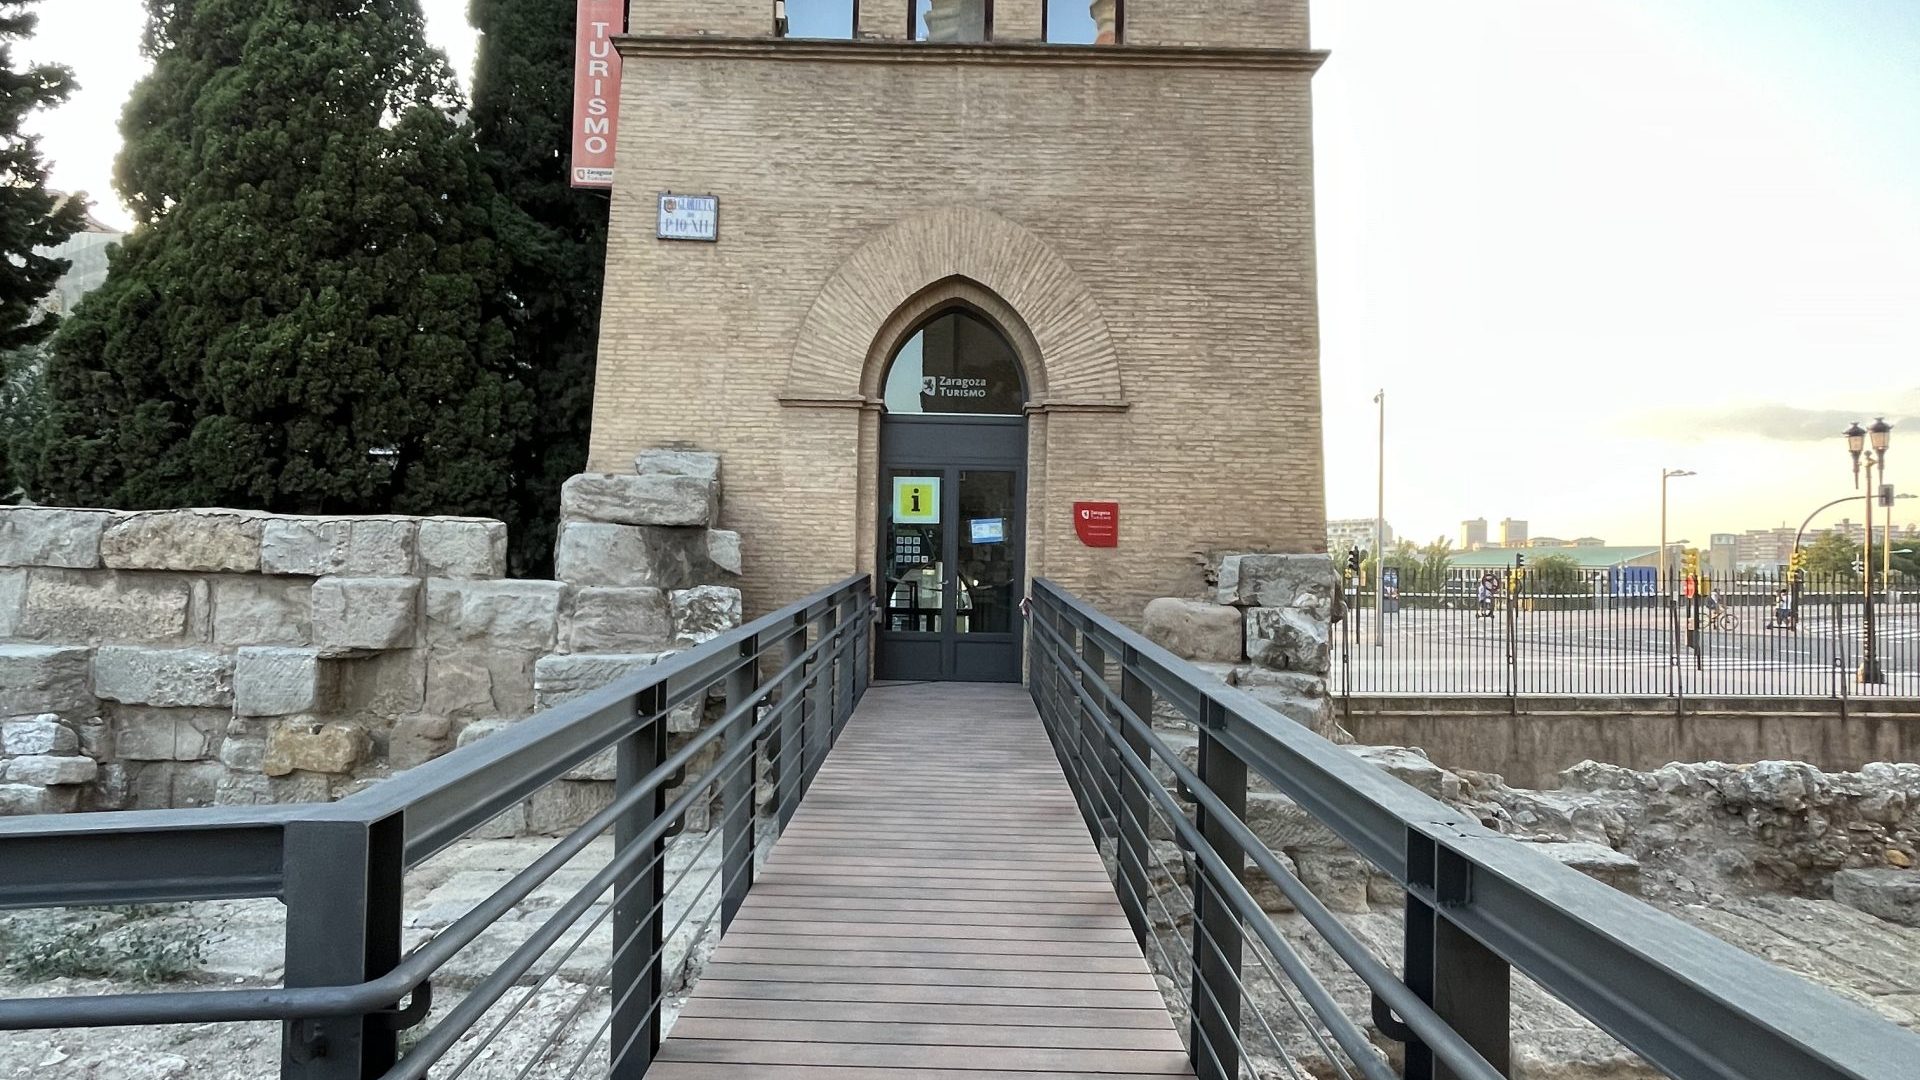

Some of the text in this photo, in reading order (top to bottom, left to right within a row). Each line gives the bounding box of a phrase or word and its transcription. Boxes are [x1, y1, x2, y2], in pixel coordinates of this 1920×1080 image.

[584, 22, 610, 153] TURISMO
[940, 376, 986, 388] Zaragoza
[940, 387, 986, 397] TURISMO
